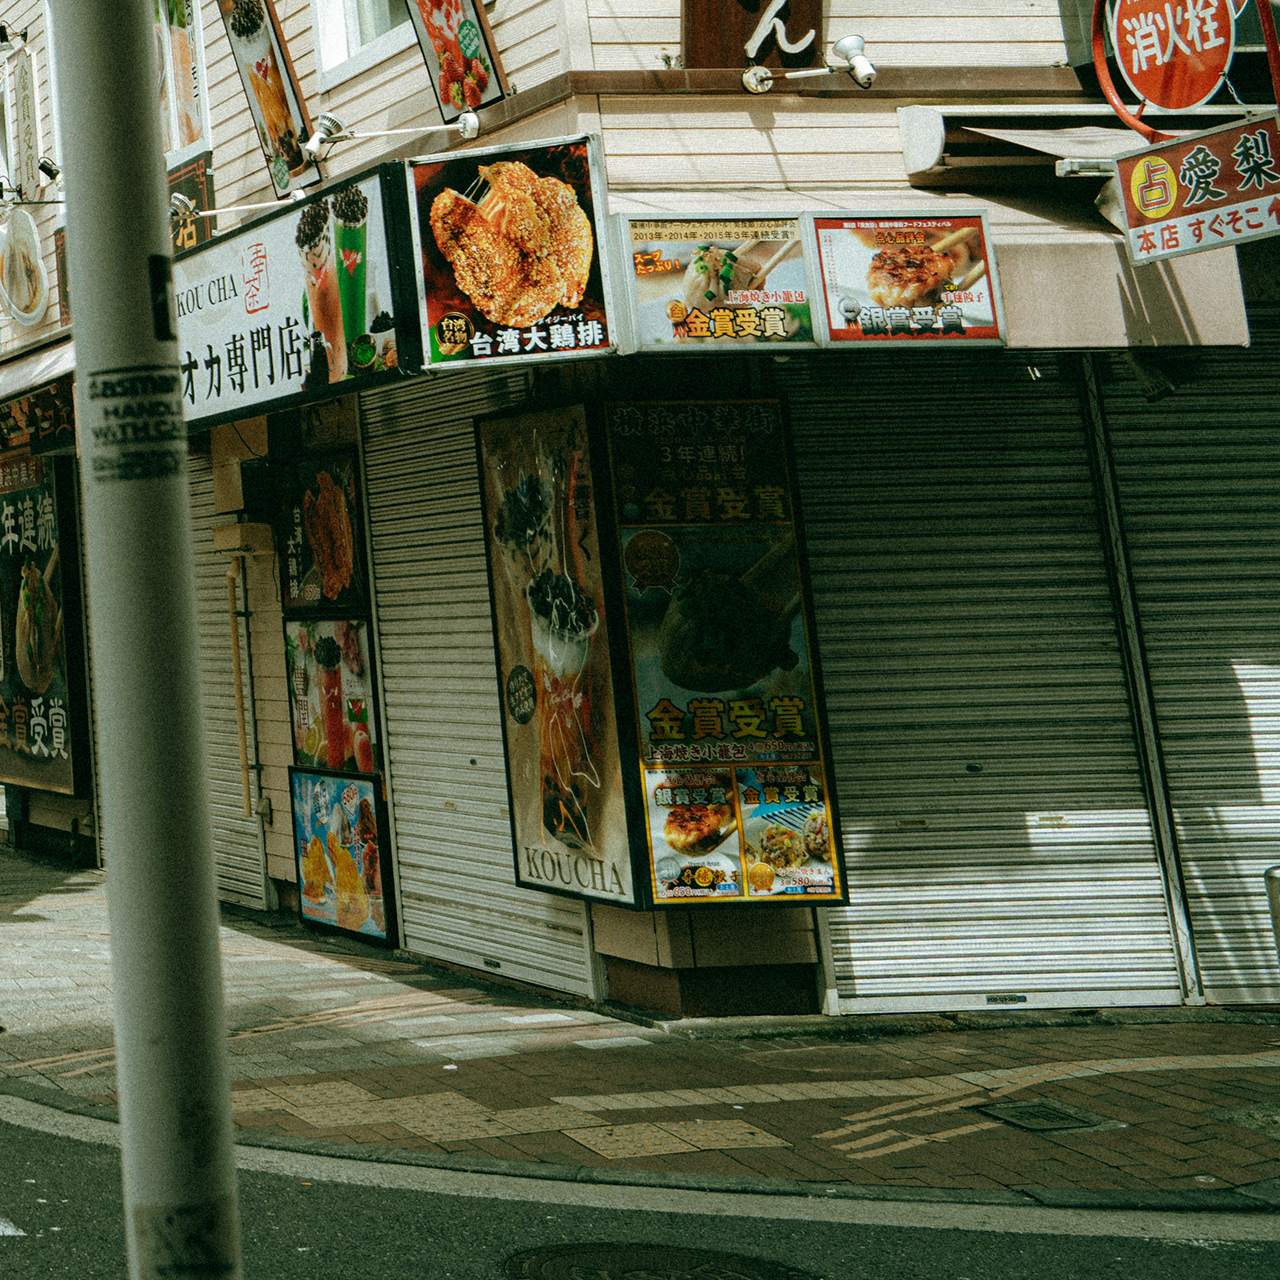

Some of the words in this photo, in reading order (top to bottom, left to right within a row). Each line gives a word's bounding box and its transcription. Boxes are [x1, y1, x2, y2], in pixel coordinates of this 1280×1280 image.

[1137, 160, 1168, 212] 占
[875, 232, 926, 244] 点心品評会
[1137, 224, 1180, 255] 本店
[1188, 206, 1264, 244] すぐそこ
[634, 249, 662, 263] スープ
[176, 284, 204, 318] KOU
[207, 273, 238, 306] CHA
[442, 318, 466, 331] 台湾
[685, 307, 788, 338] 金賞受賞
[860, 305, 967, 336] 銀賞受賞
[443, 331, 467, 344] 名物
[469, 320, 604, 356] 台湾大鶏排
[180, 316, 304, 406] オカ専門店
[643, 484, 786, 521] 金賞受賞
[645, 696, 807, 740] 金賞受賞
[646, 743, 748, 762] 上海焼き小籠包
[655, 786, 727, 805] 銀賞受賞
[743, 785, 819, 804] 金賞受賞
[524, 846, 626, 896] KOUCHA
